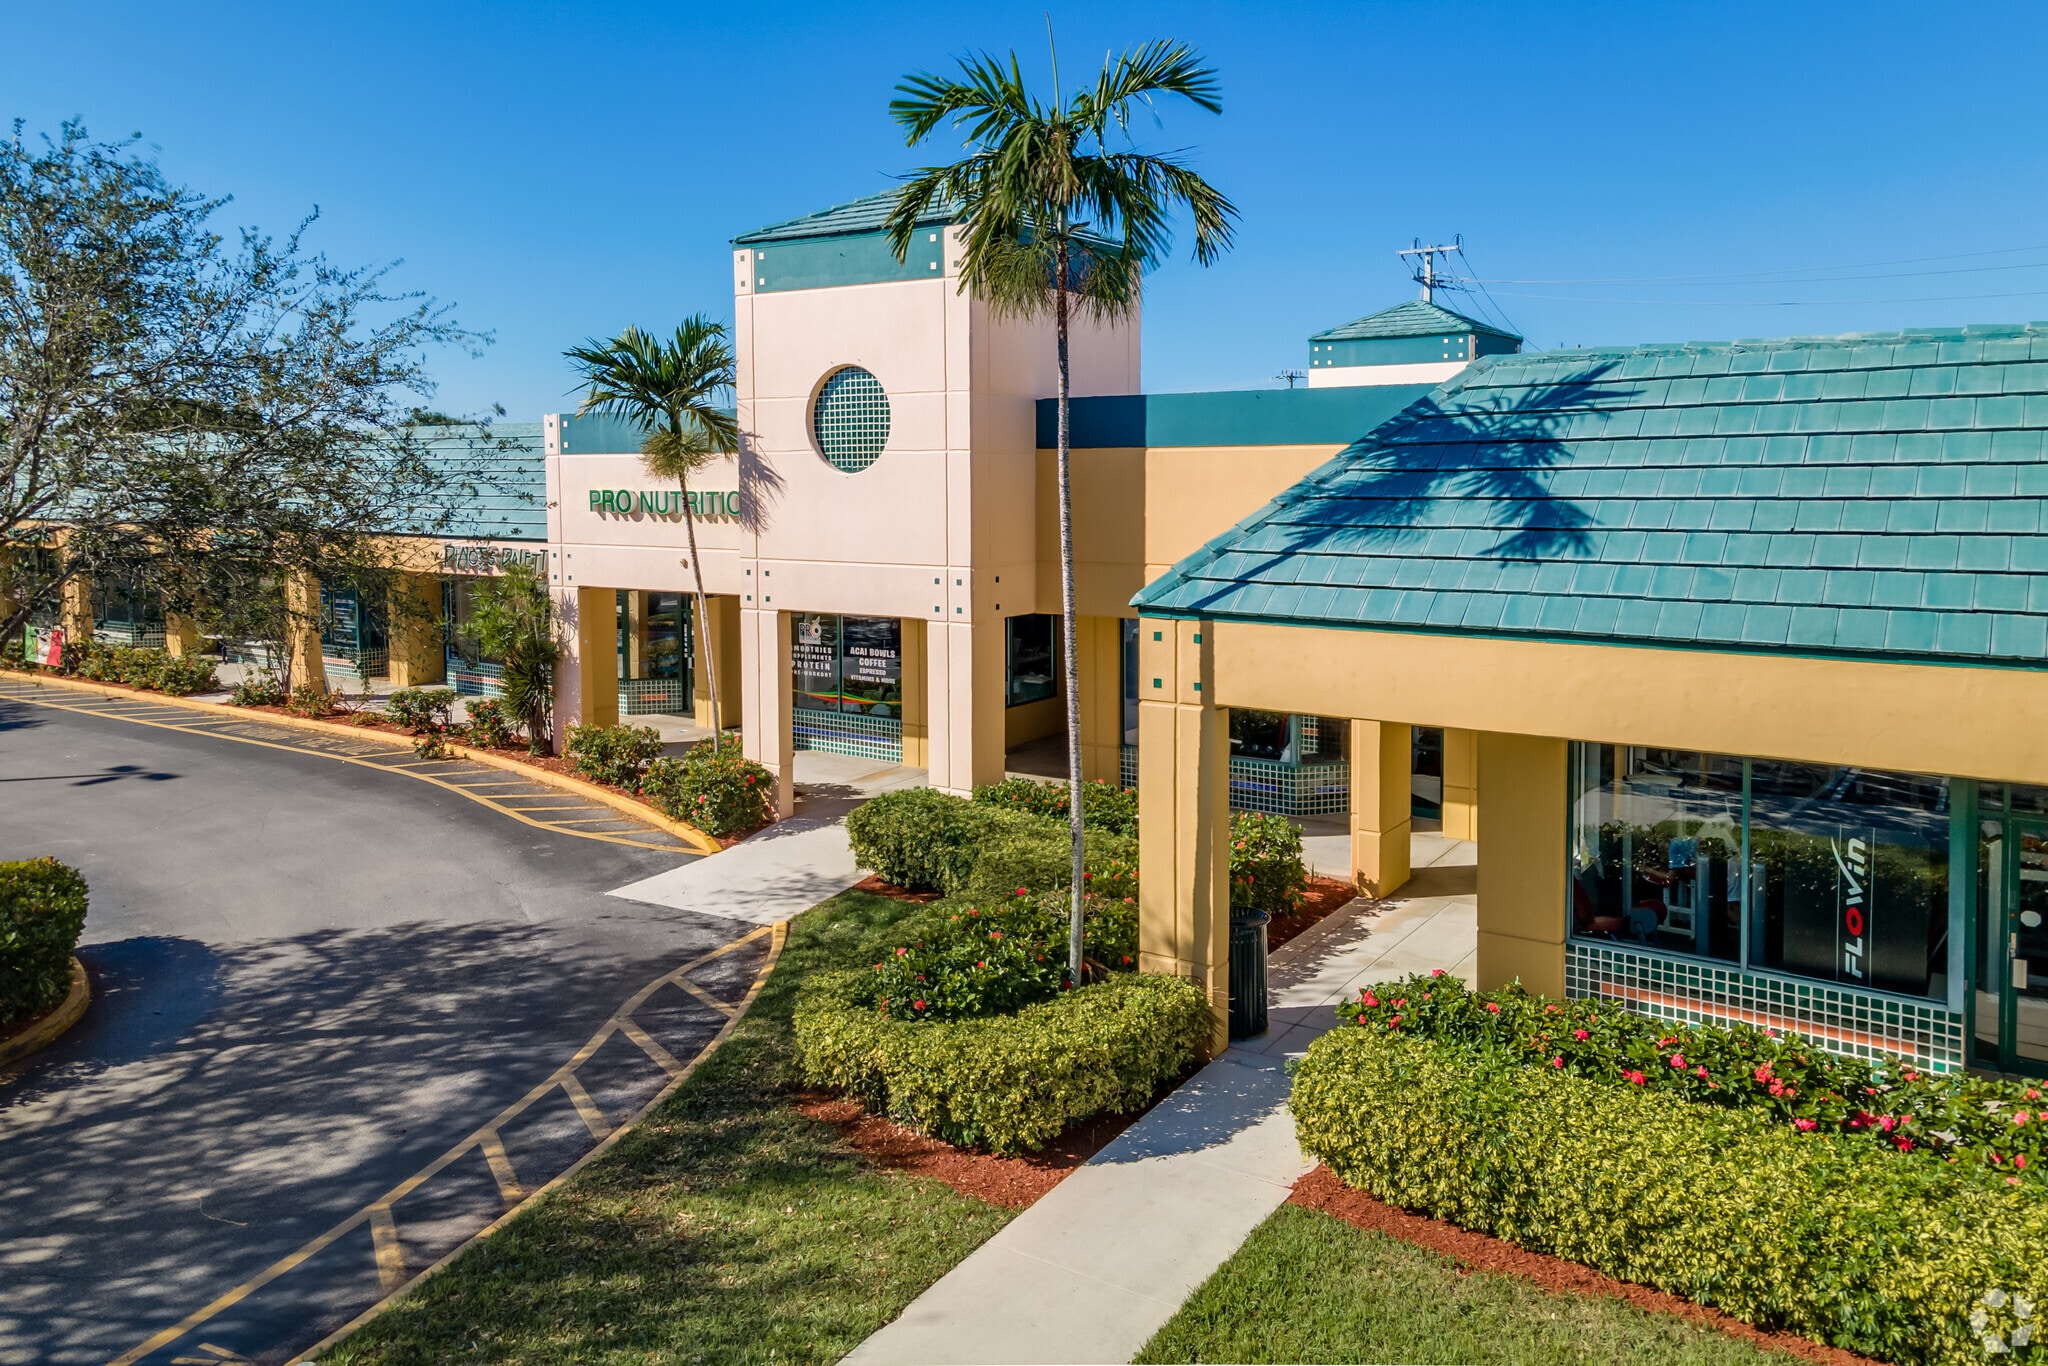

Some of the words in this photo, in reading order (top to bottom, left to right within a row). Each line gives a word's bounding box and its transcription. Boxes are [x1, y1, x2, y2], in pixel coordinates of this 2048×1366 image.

[589, 489, 632, 513] PRO
[640, 490, 740, 516] NUTRITIO
[501, 547, 549, 575] PALETT
[792, 644, 832, 654] MOOTHIES
[850, 646, 868, 656] ACAI
[869, 648, 896, 659] BOWLS
[792, 652, 832, 661] UPPLEMENTS
[791, 660, 831, 671] PROTEIN
[859, 657, 887, 668] COFFEE
[792, 669, 832, 678] RE-WORKOUT
